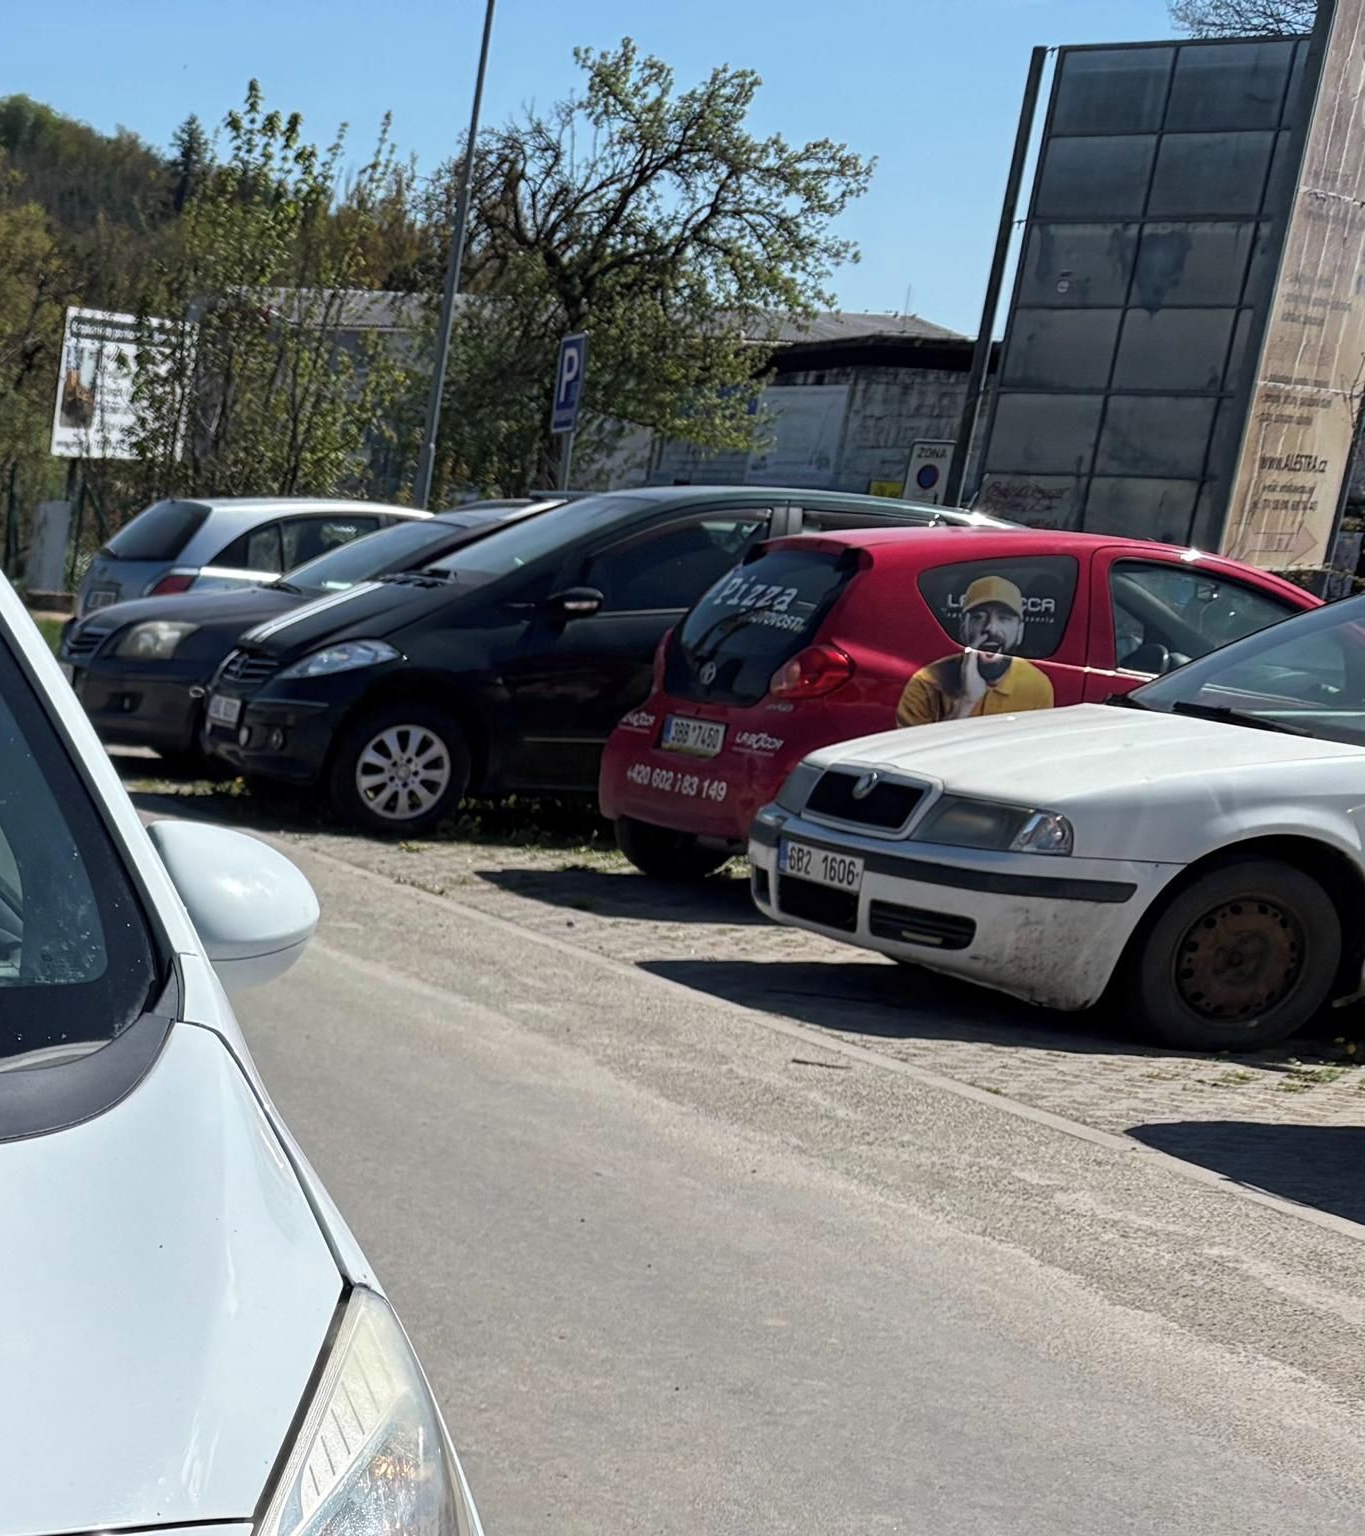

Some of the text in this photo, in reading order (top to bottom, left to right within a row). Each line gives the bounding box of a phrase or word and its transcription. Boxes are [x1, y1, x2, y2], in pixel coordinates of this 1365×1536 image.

[559, 348, 579, 402] P
[917, 447, 947, 459] ZONA
[713, 576, 798, 612] Pizza
[627, 763, 651, 785] +420
[652, 768, 674, 791] 602
[702, 778, 727, 802] 149
[789, 846, 856, 886] 6B2 1606
